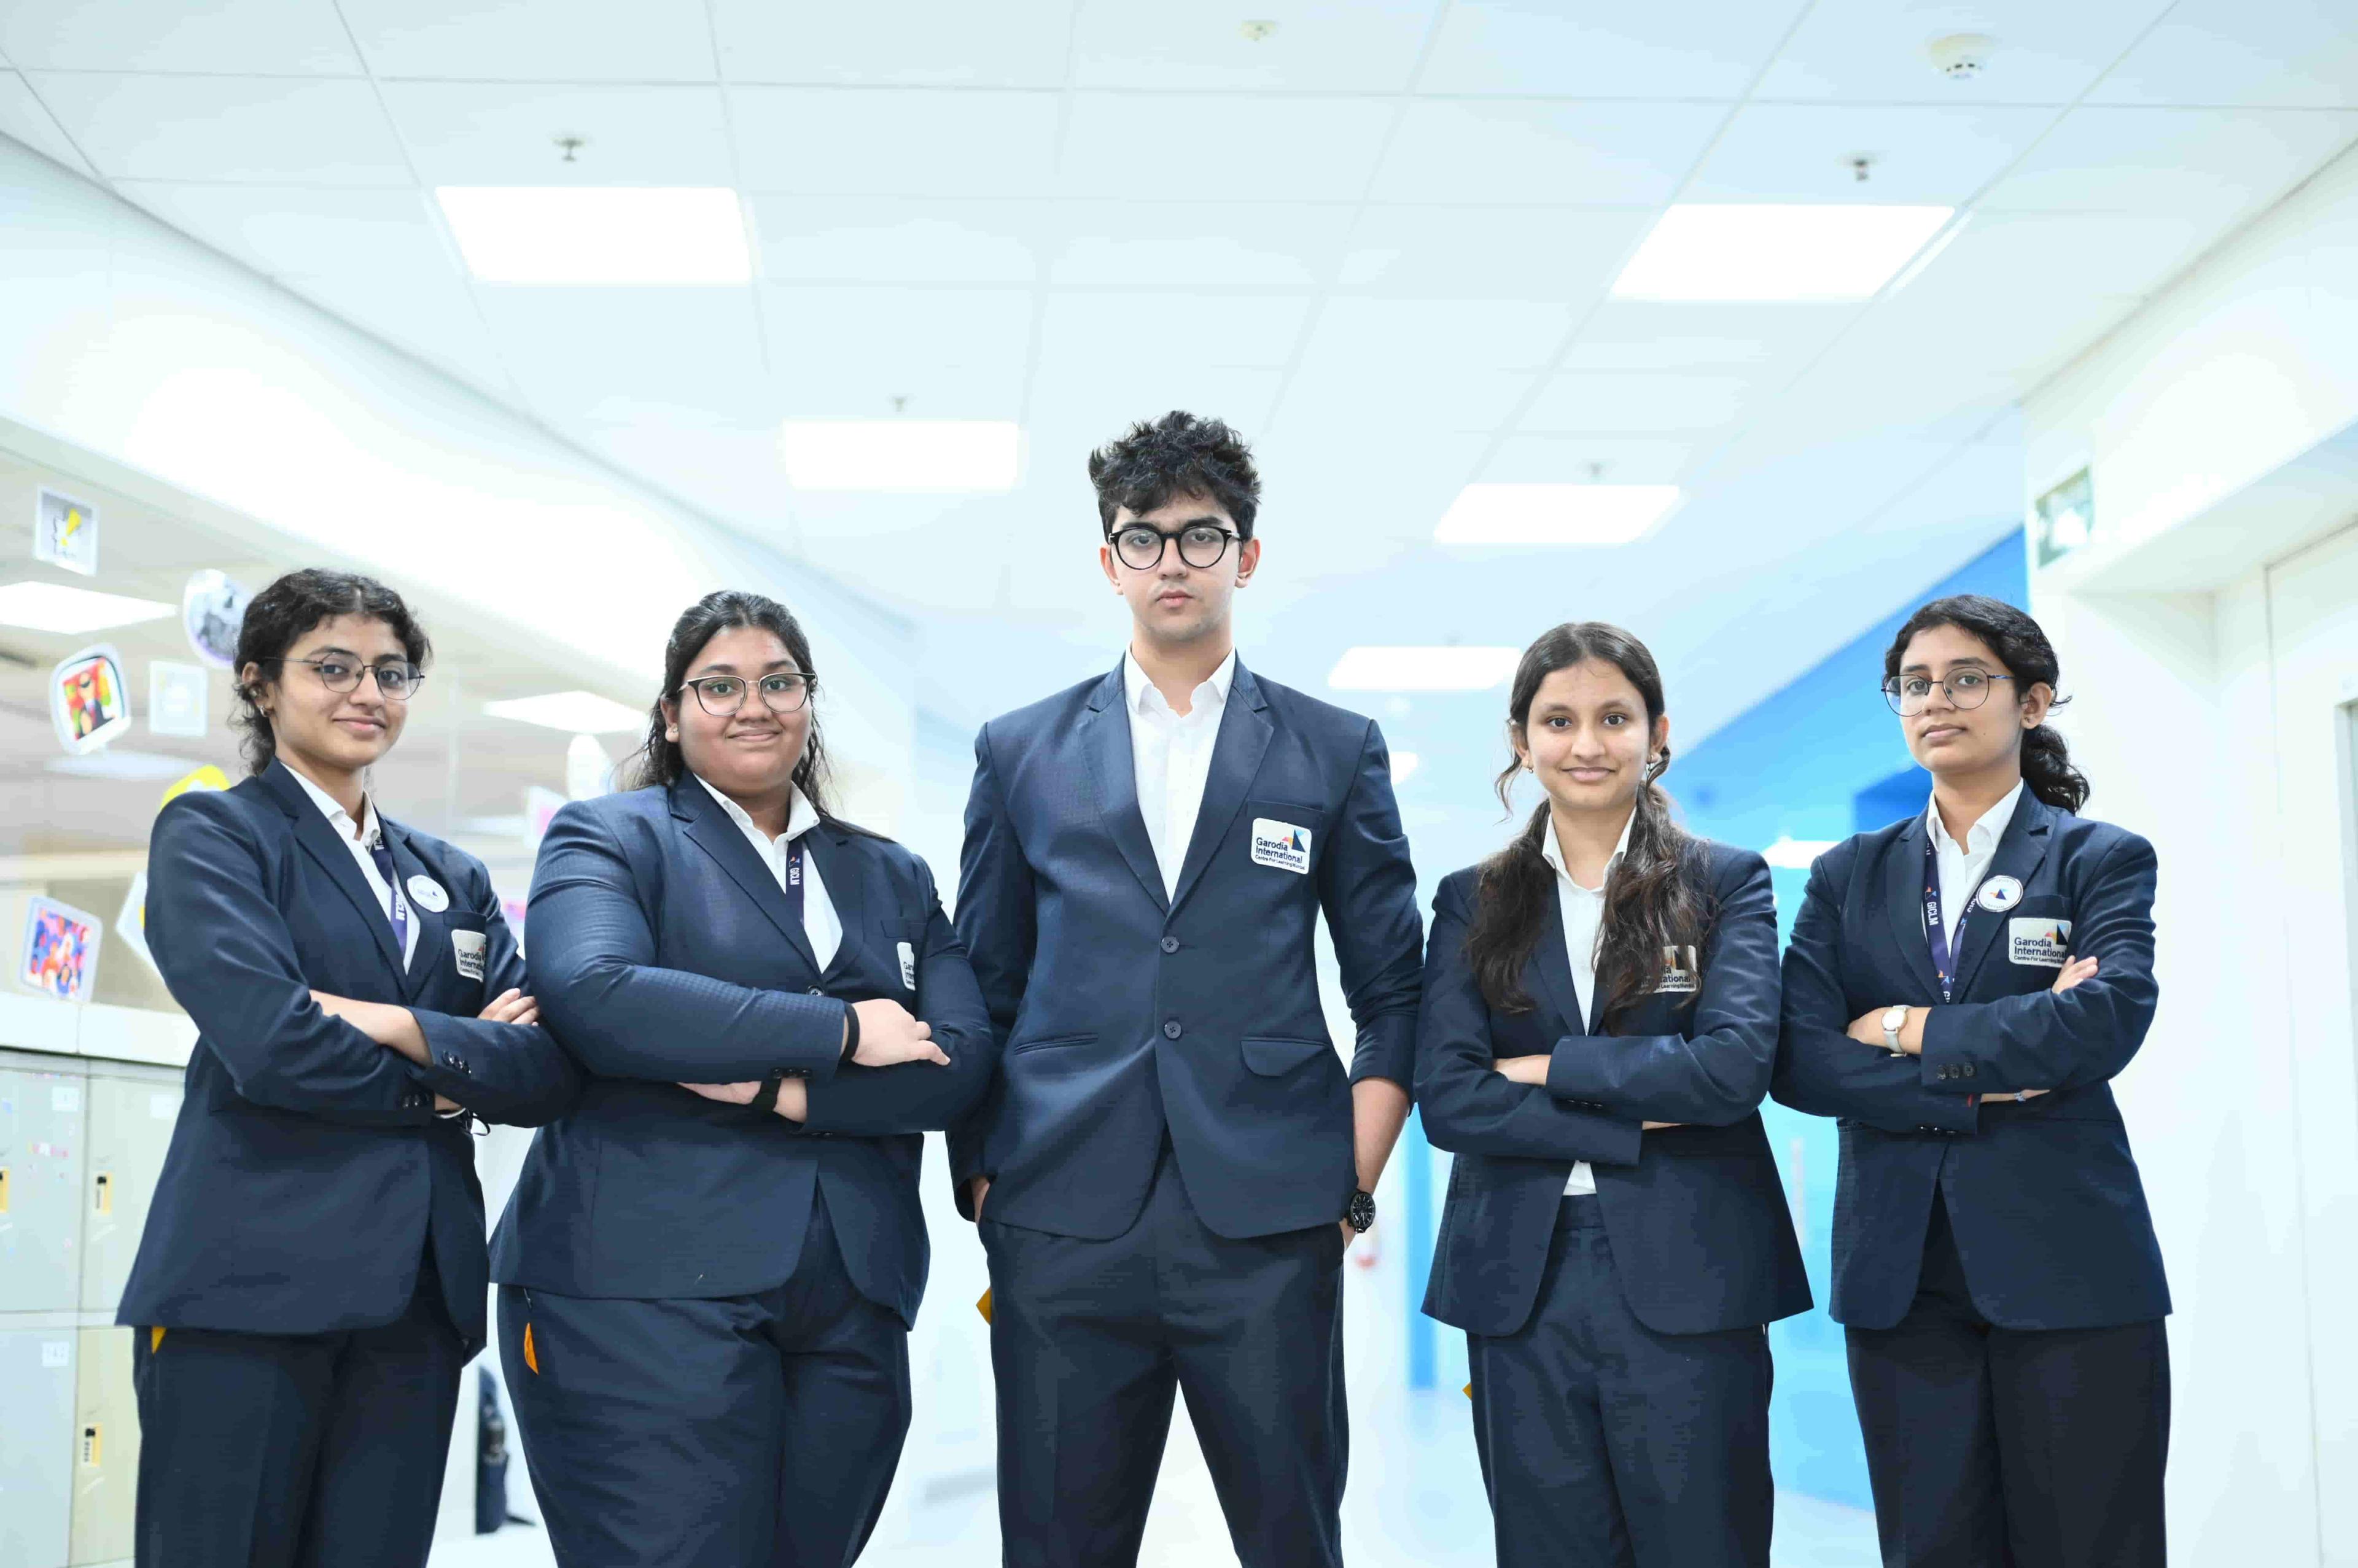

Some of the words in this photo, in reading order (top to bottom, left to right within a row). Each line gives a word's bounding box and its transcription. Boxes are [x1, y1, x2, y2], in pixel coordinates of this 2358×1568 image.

[1256, 837, 1288, 851] Garodia
[1256, 845, 1302, 864] International
[1927, 902, 1939, 926] GICLM
[2014, 937, 2052, 948] Garodia
[2014, 946, 2067, 958] International
